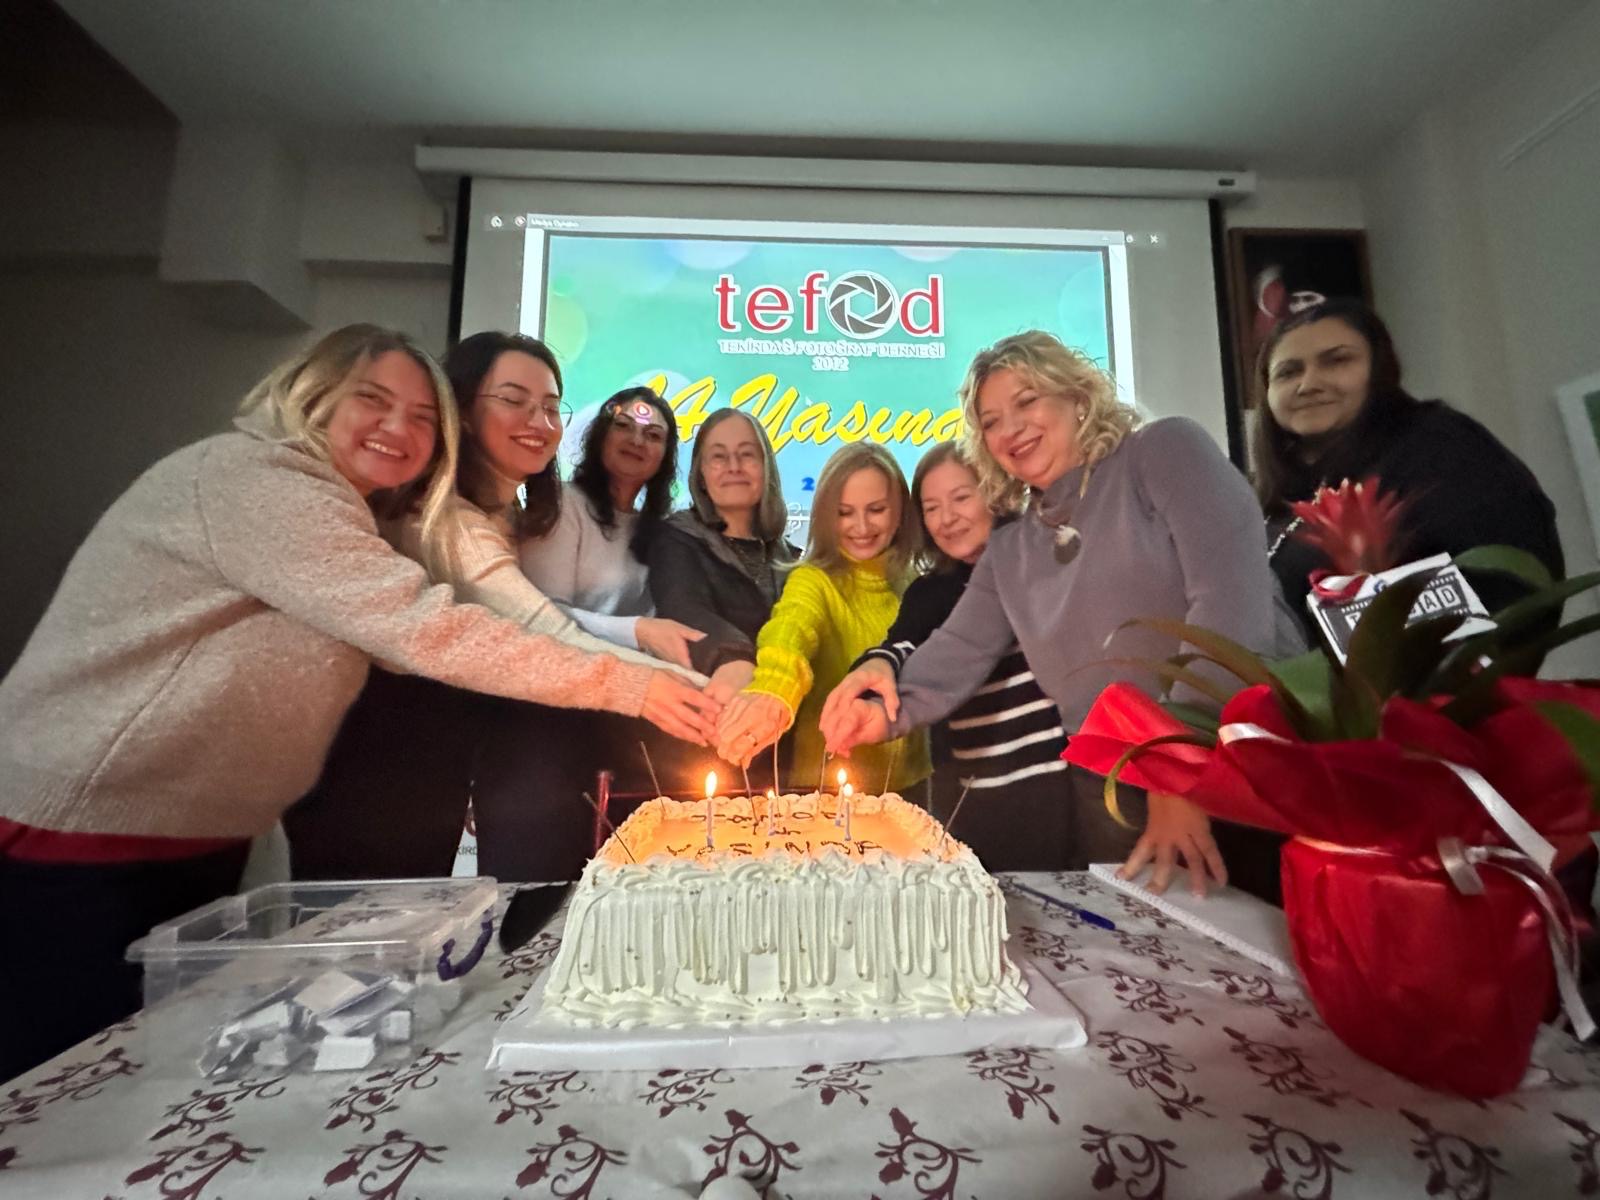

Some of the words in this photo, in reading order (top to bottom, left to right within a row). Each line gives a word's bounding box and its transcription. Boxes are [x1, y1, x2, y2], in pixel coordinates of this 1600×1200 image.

[718, 338, 794, 354] TEKİRDAĞ
[795, 339, 876, 357] FOTOĞRAF
[811, 356, 849, 371] 2012
